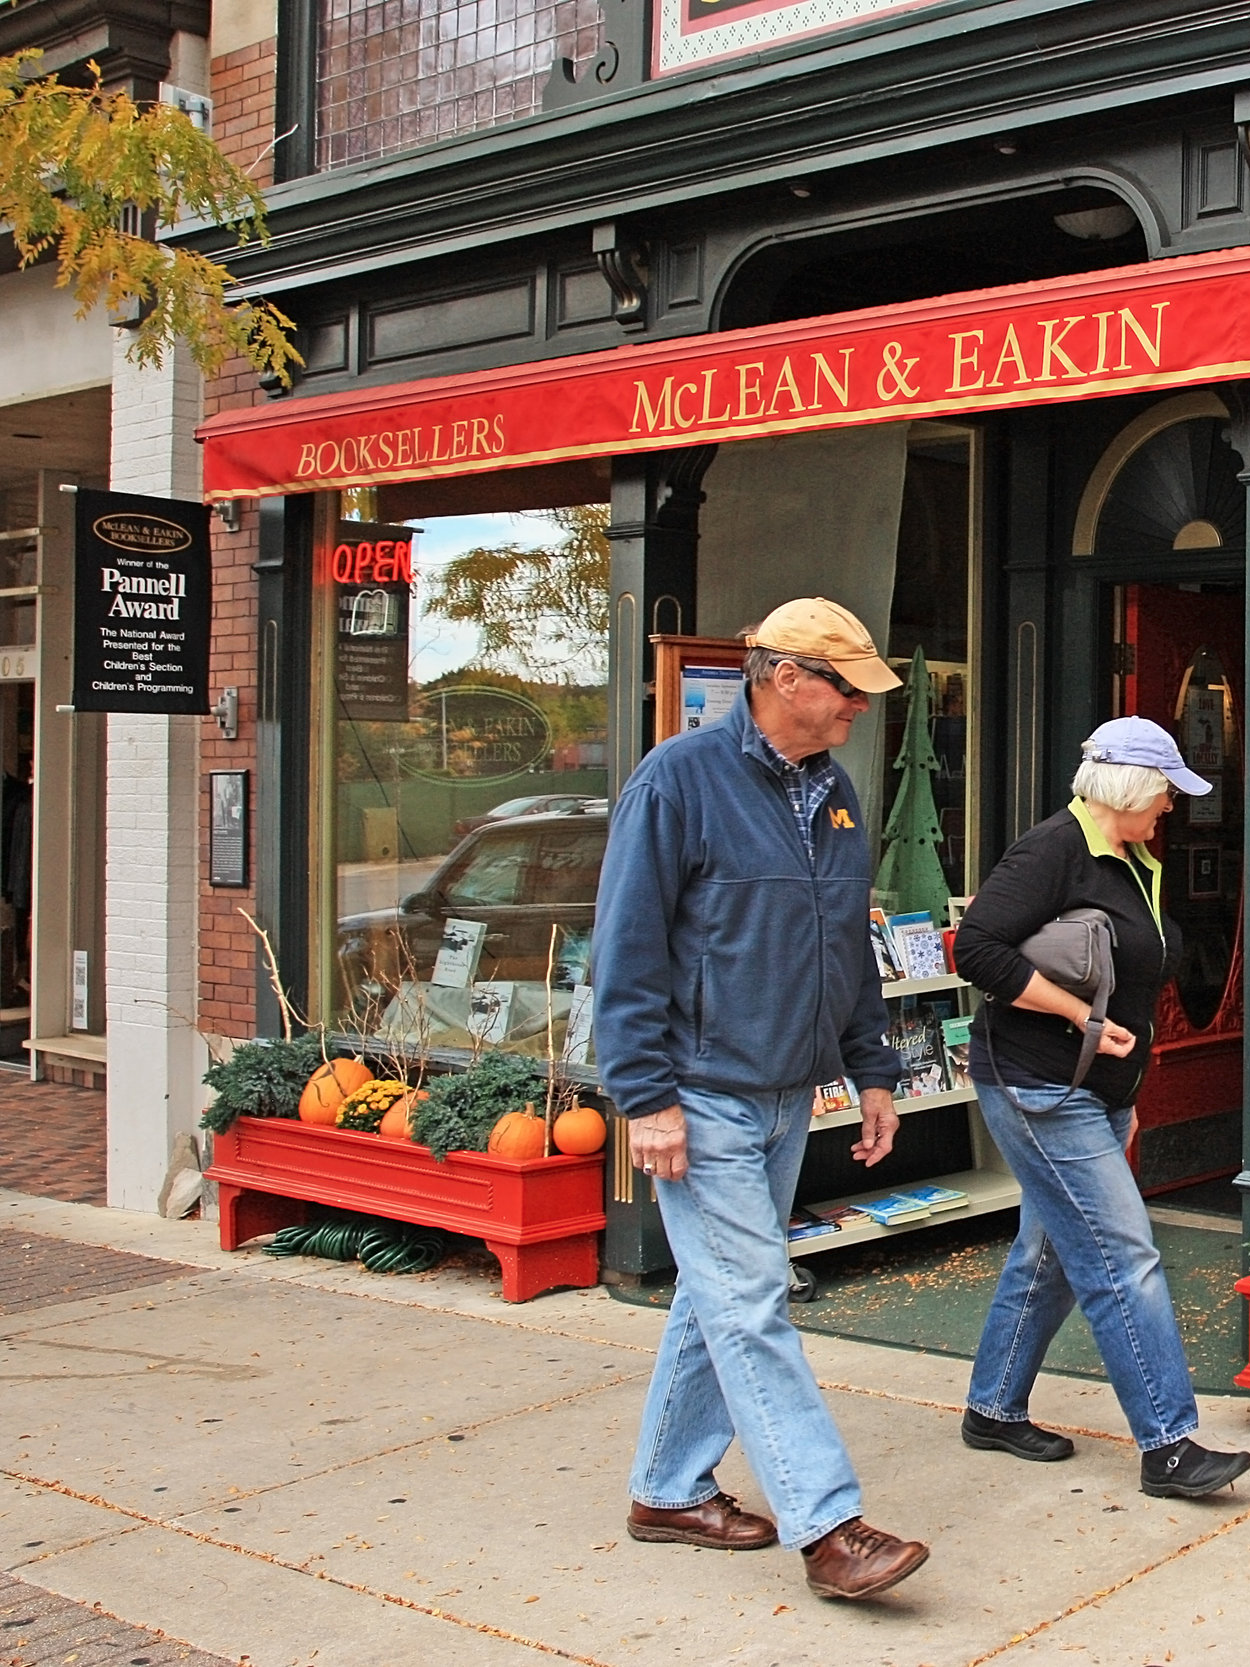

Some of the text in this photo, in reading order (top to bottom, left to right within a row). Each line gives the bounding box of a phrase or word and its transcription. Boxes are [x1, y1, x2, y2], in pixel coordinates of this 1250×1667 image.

[628, 301, 1171, 433] McLEAN & EAKIN
[294, 413, 505, 477] BOOKSELLERS
[102, 521, 184, 539] McLEAN & EAKIN
[111, 531, 176, 547] BOOKSELLERS
[116, 558, 170, 570] Winner of the
[332, 540, 415, 584] OPEN
[101, 567, 187, 598] Pannell
[108, 594, 180, 621] Award
[99, 627, 185, 641] The National Award
[103, 640, 181, 652] Presented for the
[132, 651, 153, 661] Best
[103, 660, 183, 672] Children's Section
[135, 672, 152, 681] and
[91, 681, 194, 694] Children's Programming
[828, 806, 855, 829] M
[891, 1025, 926, 1050] ltered
[900, 1043, 934, 1062] Style
[822, 1084, 846, 1099] FIRE
